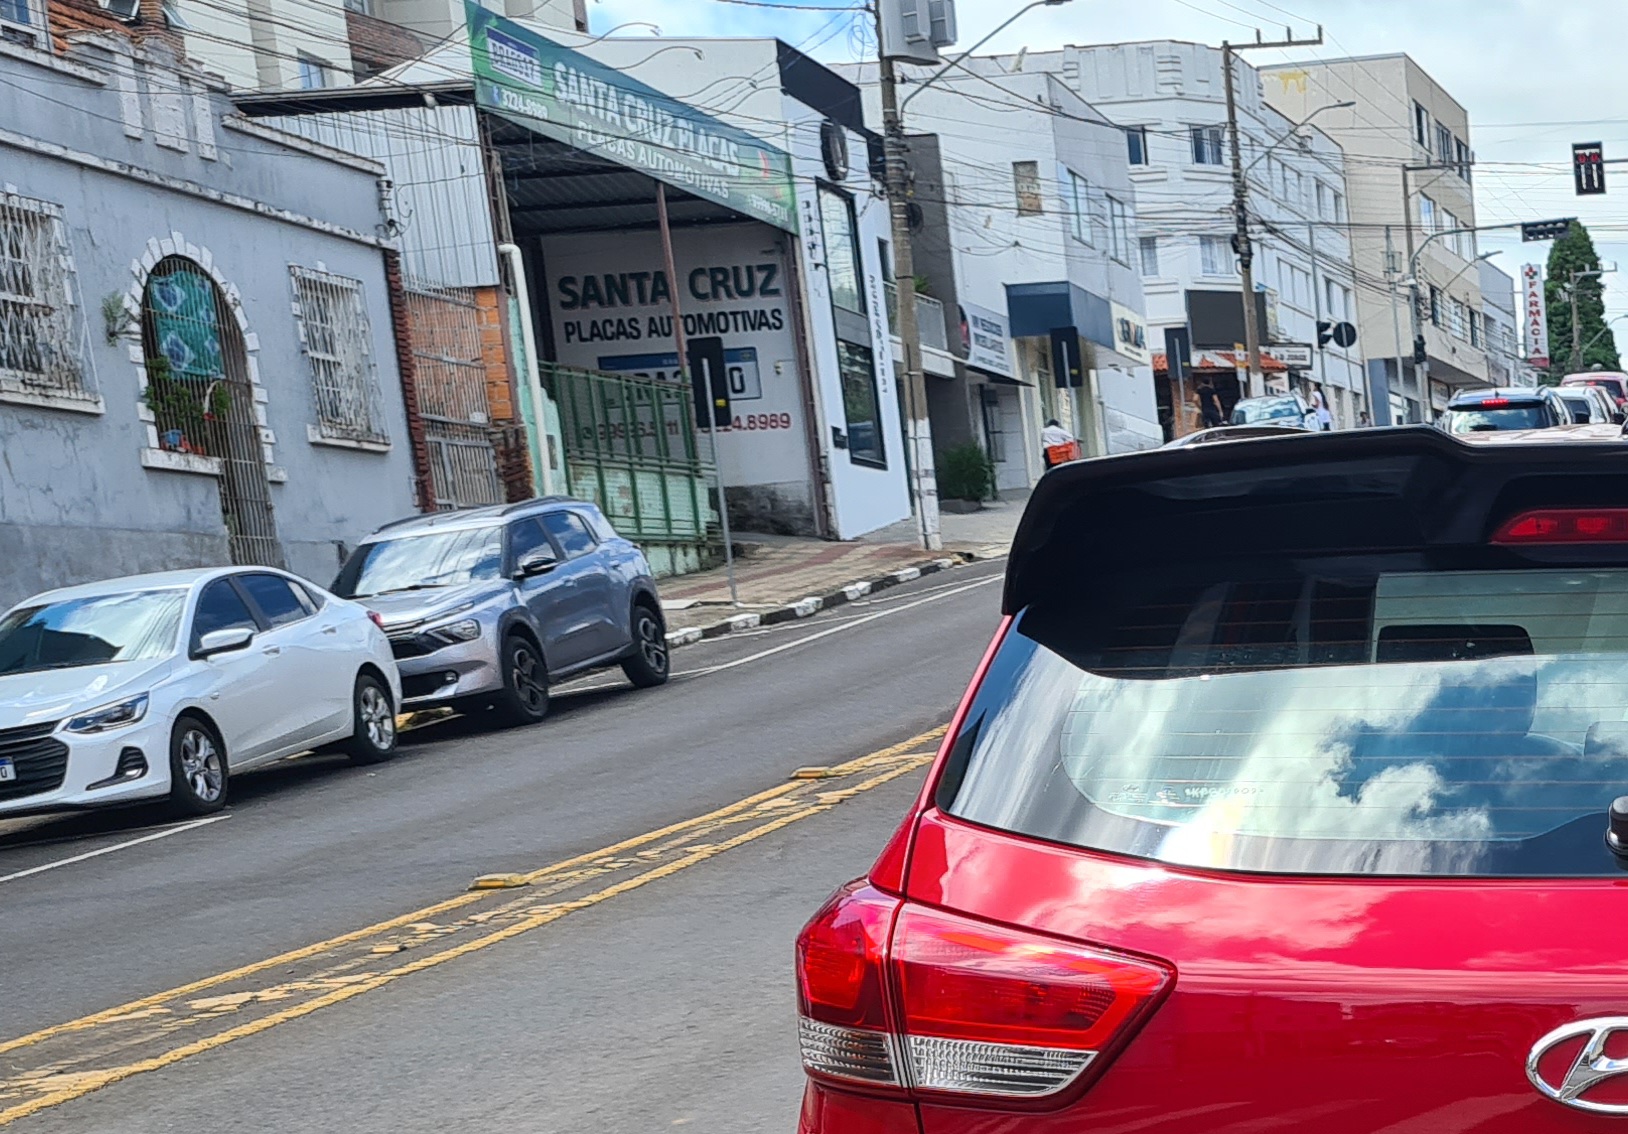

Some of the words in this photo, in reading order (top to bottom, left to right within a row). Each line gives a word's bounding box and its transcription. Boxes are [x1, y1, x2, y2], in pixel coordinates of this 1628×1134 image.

[554, 61, 621, 127] SANTA
[623, 94, 675, 148] CRUZ
[577, 120, 636, 161] PLACAS
[638, 146, 729, 199] AUTOMOTIVAS
[558, 270, 672, 310] SANTA
[688, 263, 782, 302] CRUZ
[564, 318, 641, 344] PLACAS
